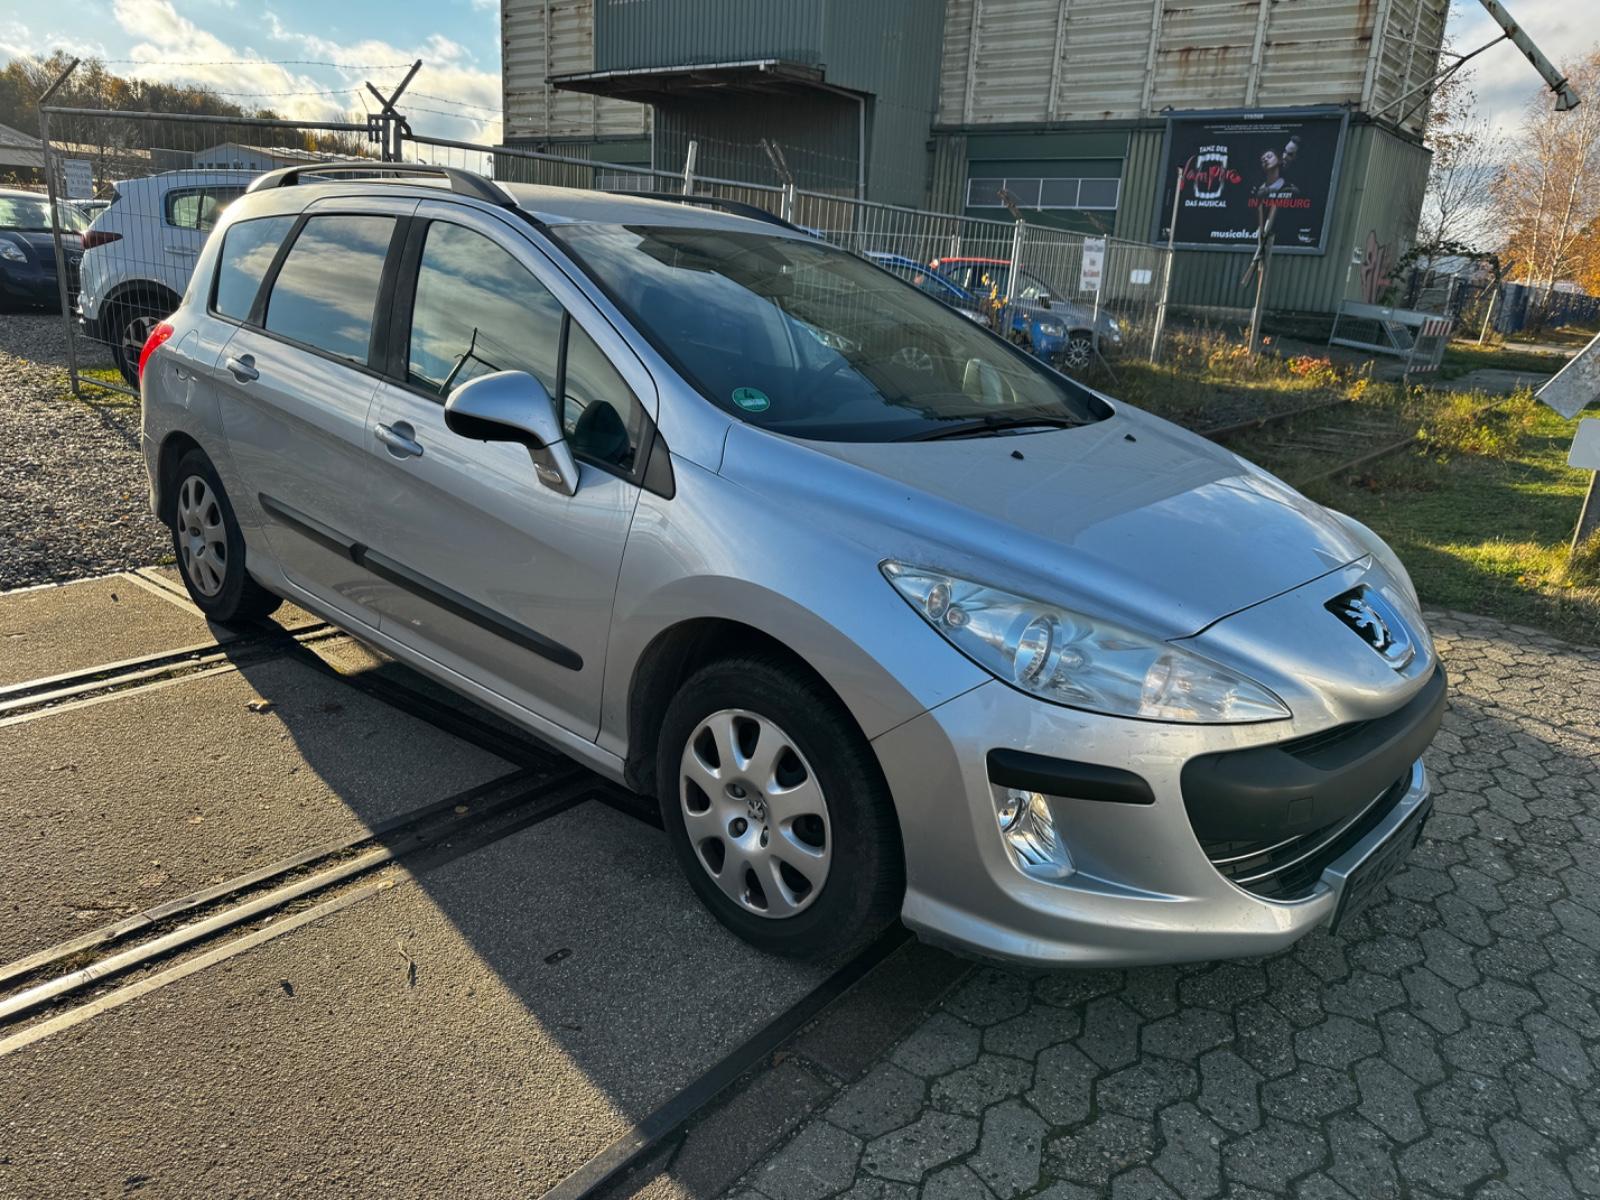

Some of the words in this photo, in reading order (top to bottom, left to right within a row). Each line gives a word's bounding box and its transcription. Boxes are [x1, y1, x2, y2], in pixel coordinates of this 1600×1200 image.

[1199, 145, 1216, 153] TANZ
[1216, 145, 1227, 153] DER
[1198, 200, 1227, 208] MUSICAL
[1248, 198, 1258, 208] IN
[1262, 198, 1311, 208] HAMBURG
[1210, 228, 1260, 239] musicals.d
